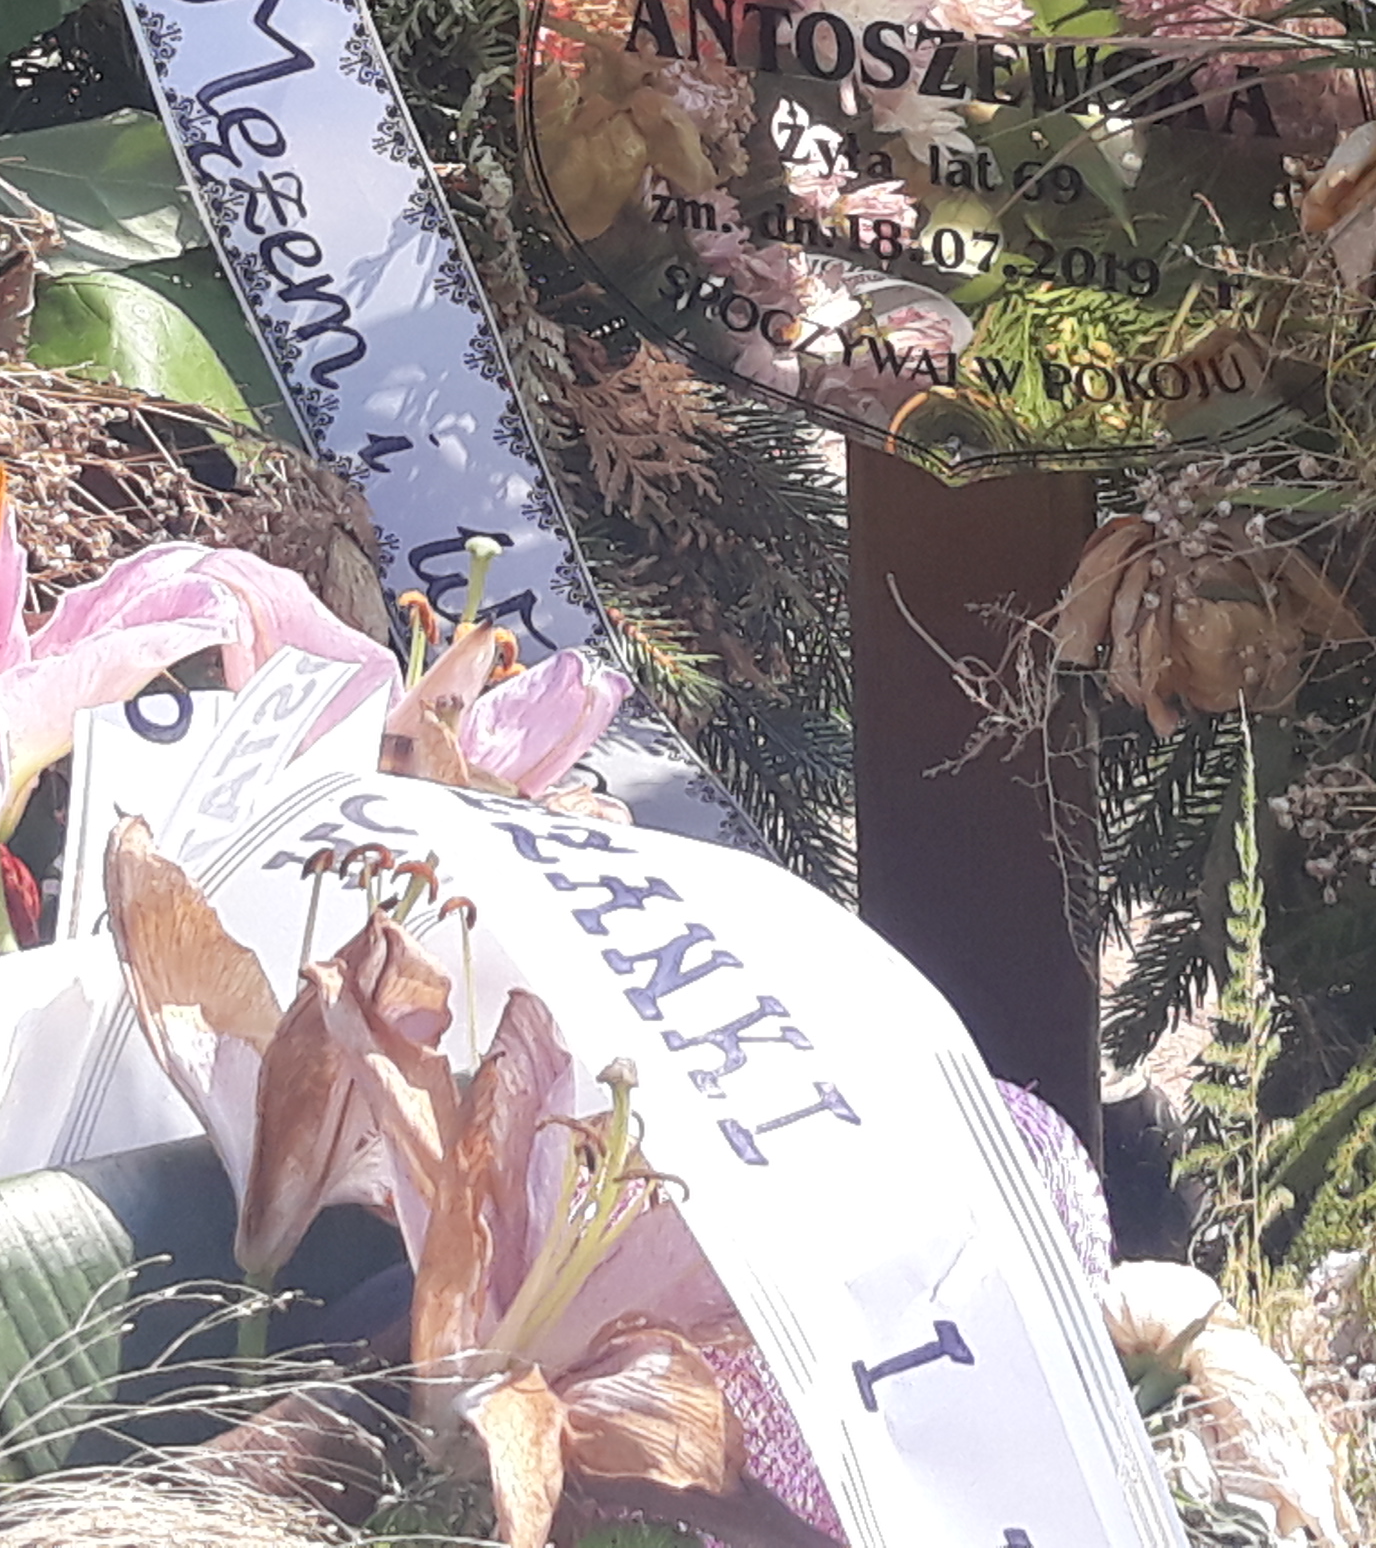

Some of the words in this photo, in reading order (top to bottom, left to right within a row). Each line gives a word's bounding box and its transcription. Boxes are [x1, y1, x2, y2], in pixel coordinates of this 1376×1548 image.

[929, 143, 995, 192] lat
[1013, 161, 1083, 204] 69
[651, 194, 732, 234] zm.
[847, 213, 1160, 298] 18.07.2019
[974, 356, 1022, 396] W
[1043, 352, 1247, 409] POKOJU
